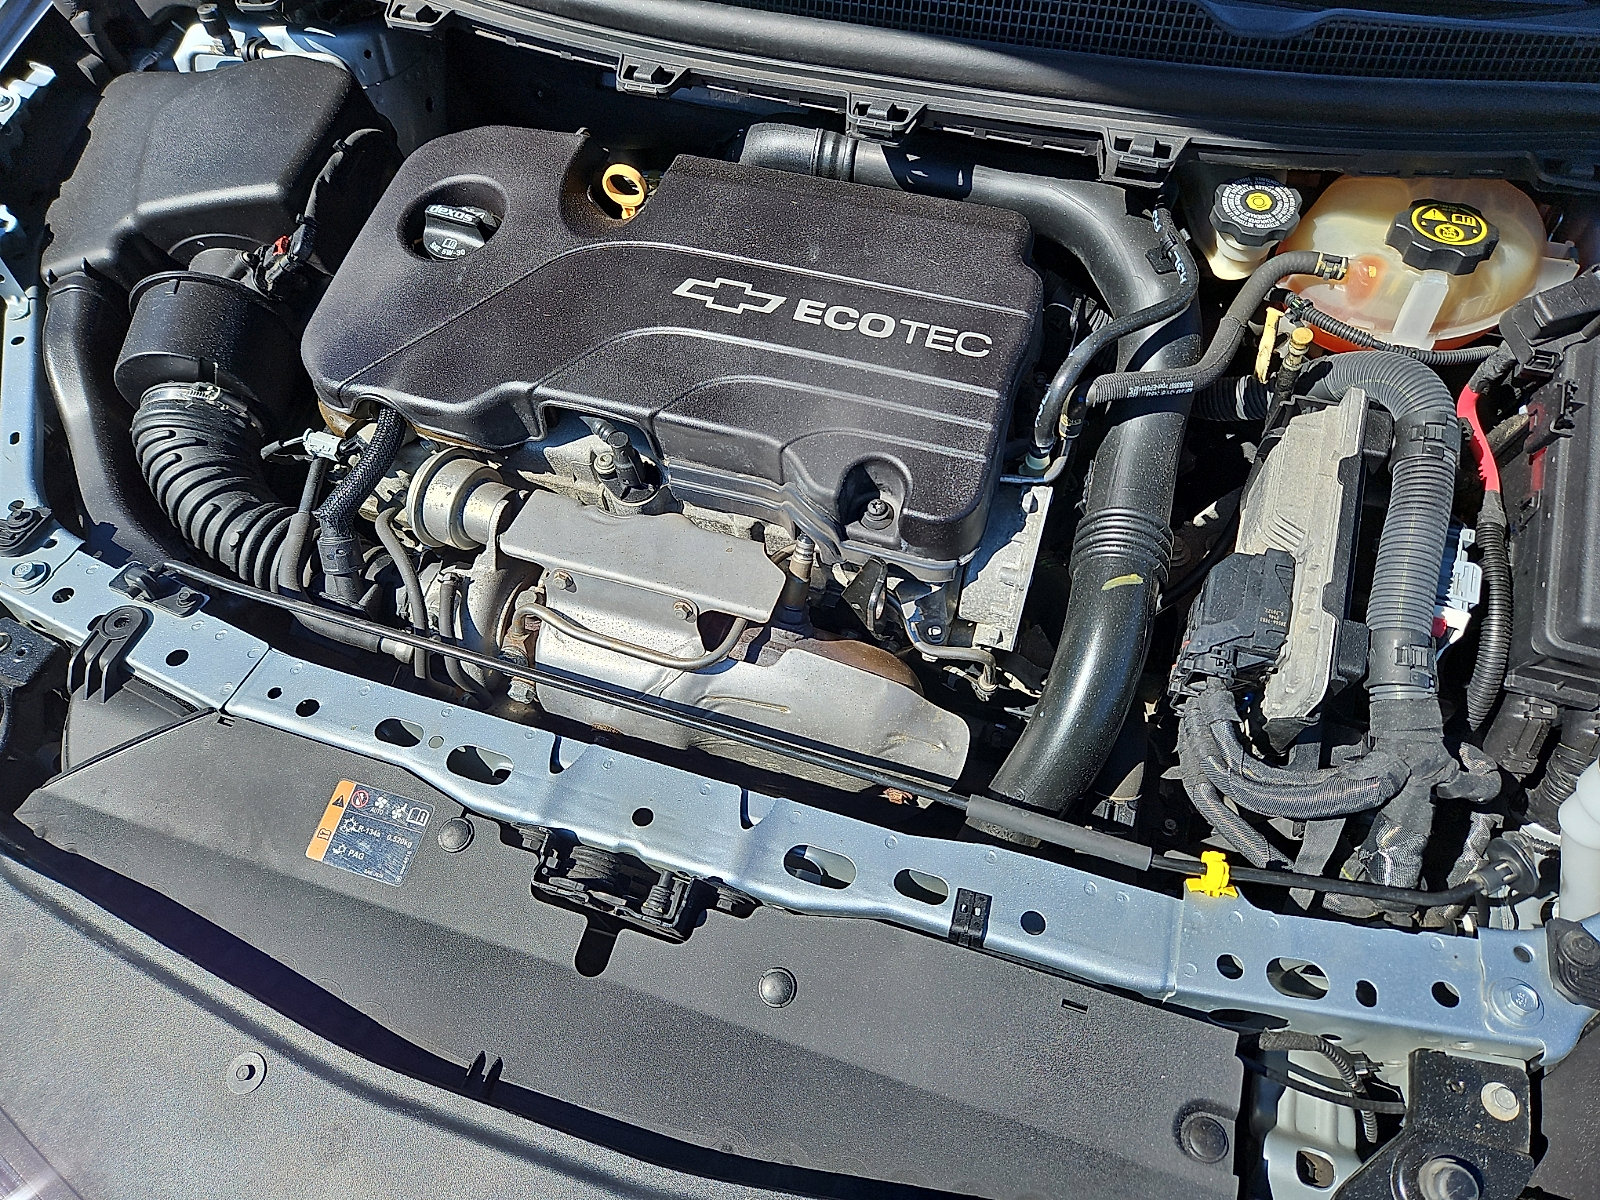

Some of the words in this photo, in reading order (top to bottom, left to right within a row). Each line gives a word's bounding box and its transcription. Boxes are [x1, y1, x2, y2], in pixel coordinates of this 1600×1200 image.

[429, 205, 473, 222] dexos
[793, 298, 993, 358] ECOTEC
[370, 806, 384, 815] AUTO
[358, 825, 381, 838] R-134a
[347, 849, 365, 860] PAG
